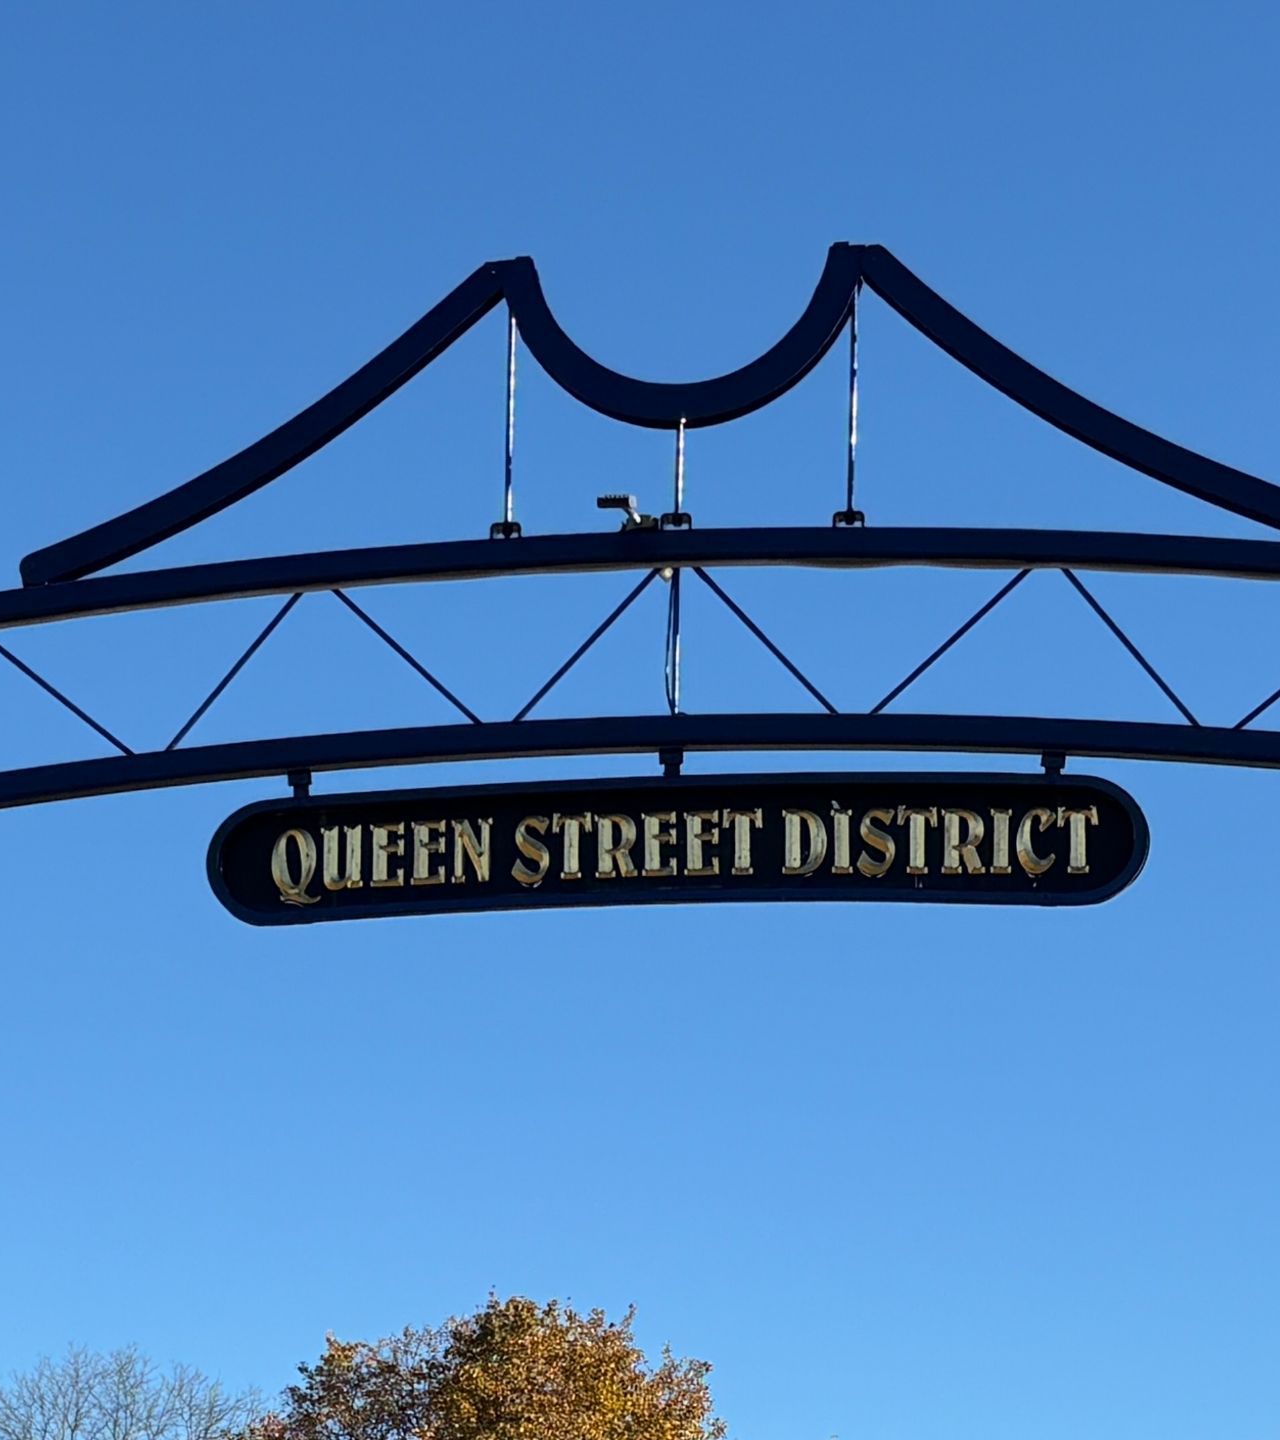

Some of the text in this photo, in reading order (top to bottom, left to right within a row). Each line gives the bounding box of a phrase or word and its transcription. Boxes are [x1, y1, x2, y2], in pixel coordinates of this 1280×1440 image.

[271, 803, 1099, 907] QUEEN STREET DISTRICT
